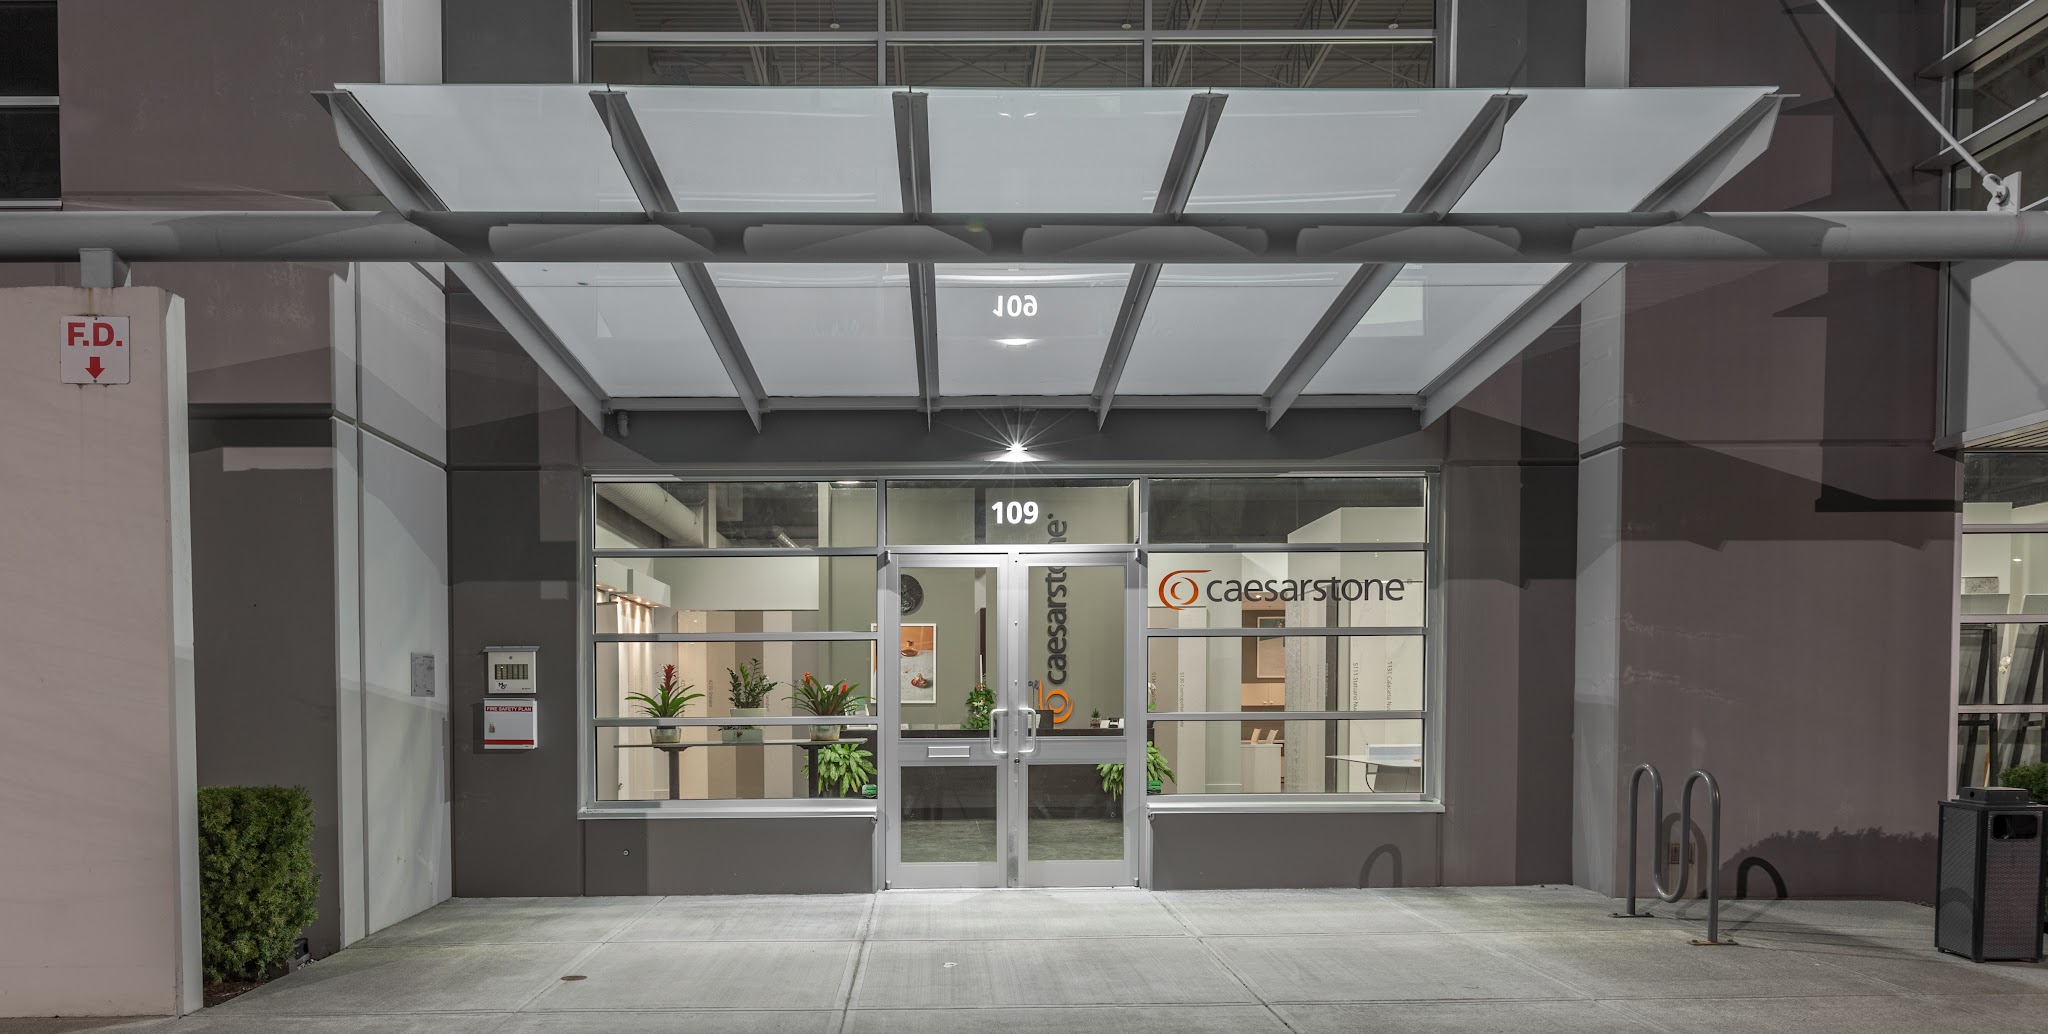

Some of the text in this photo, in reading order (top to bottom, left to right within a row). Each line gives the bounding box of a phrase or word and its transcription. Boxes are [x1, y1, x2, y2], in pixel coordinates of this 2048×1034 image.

[67, 322, 123, 347] F.D.
[991, 501, 1039, 524] 109
[1206, 576, 1405, 602] caesarstone
